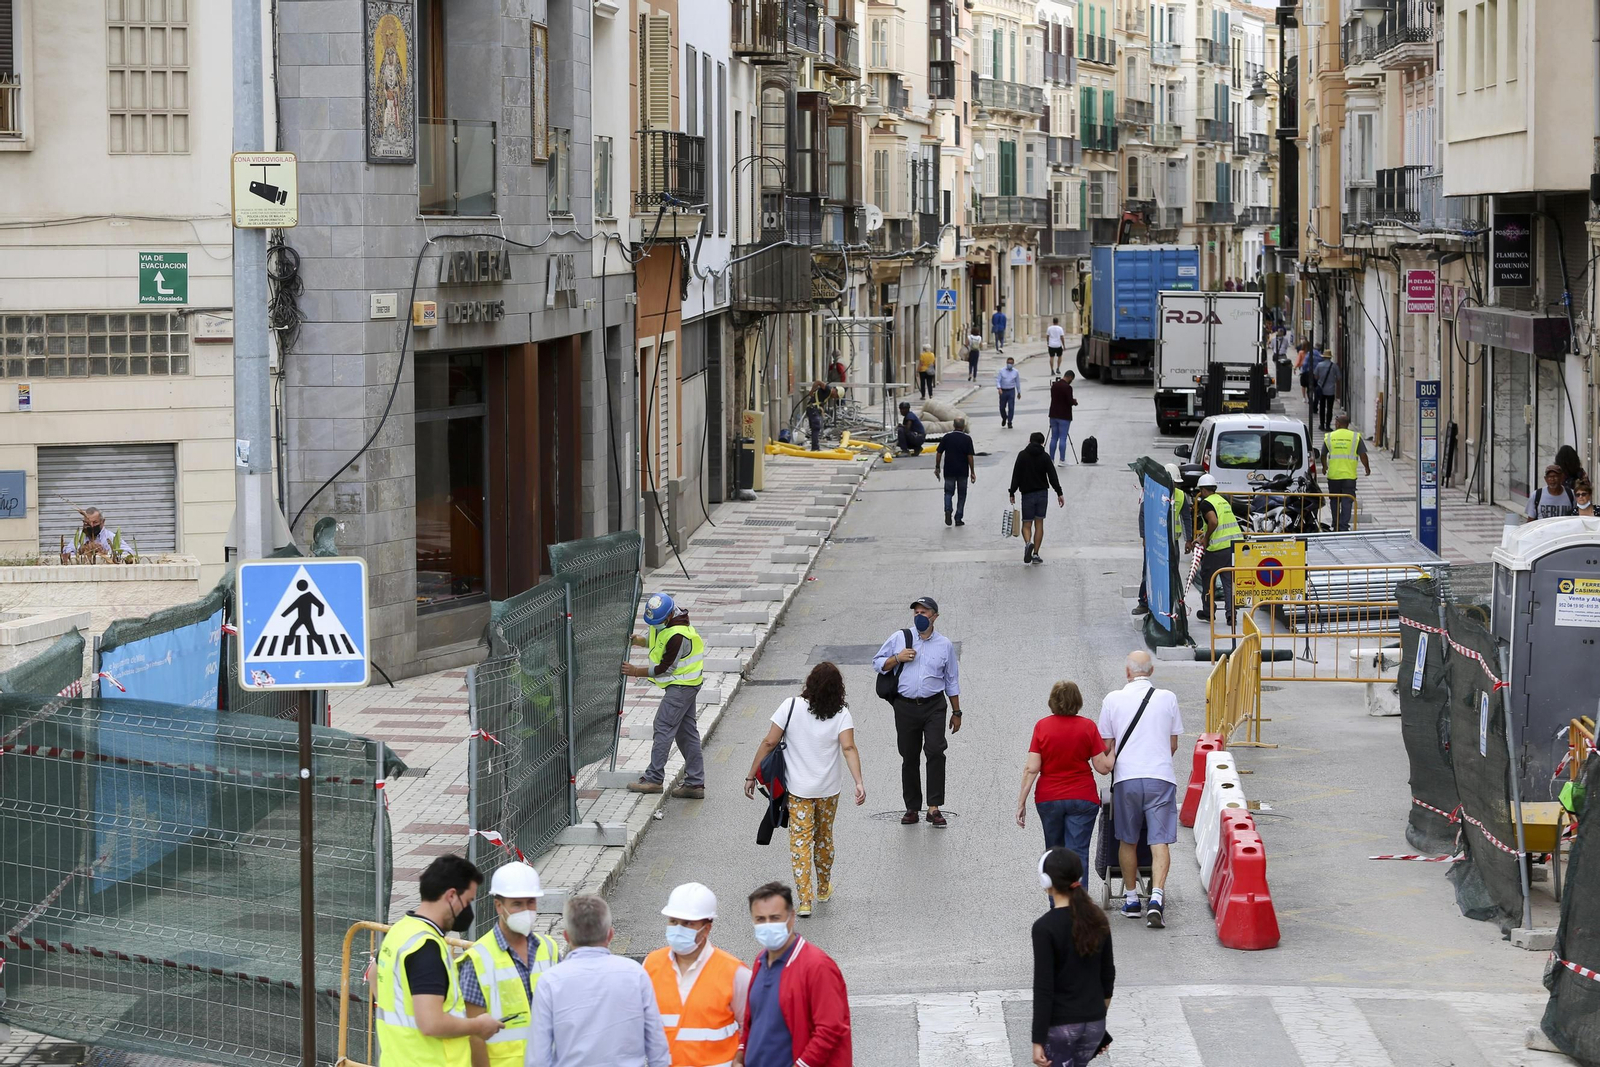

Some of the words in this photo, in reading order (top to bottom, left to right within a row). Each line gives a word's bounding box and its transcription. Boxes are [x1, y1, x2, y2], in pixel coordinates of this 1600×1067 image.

[1494, 261, 1529, 269] COMUNIÓN
[1408, 302, 1435, 311] COMUNIONES
[447, 300, 506, 324] DEPORTES
[1166, 310, 1223, 325] RDA
[1420, 384, 1437, 396] BUS
[1423, 409, 1435, 417] 36
[1236, 589, 1260, 597] PROHIBDO
[1236, 597, 1245, 605] LAS
